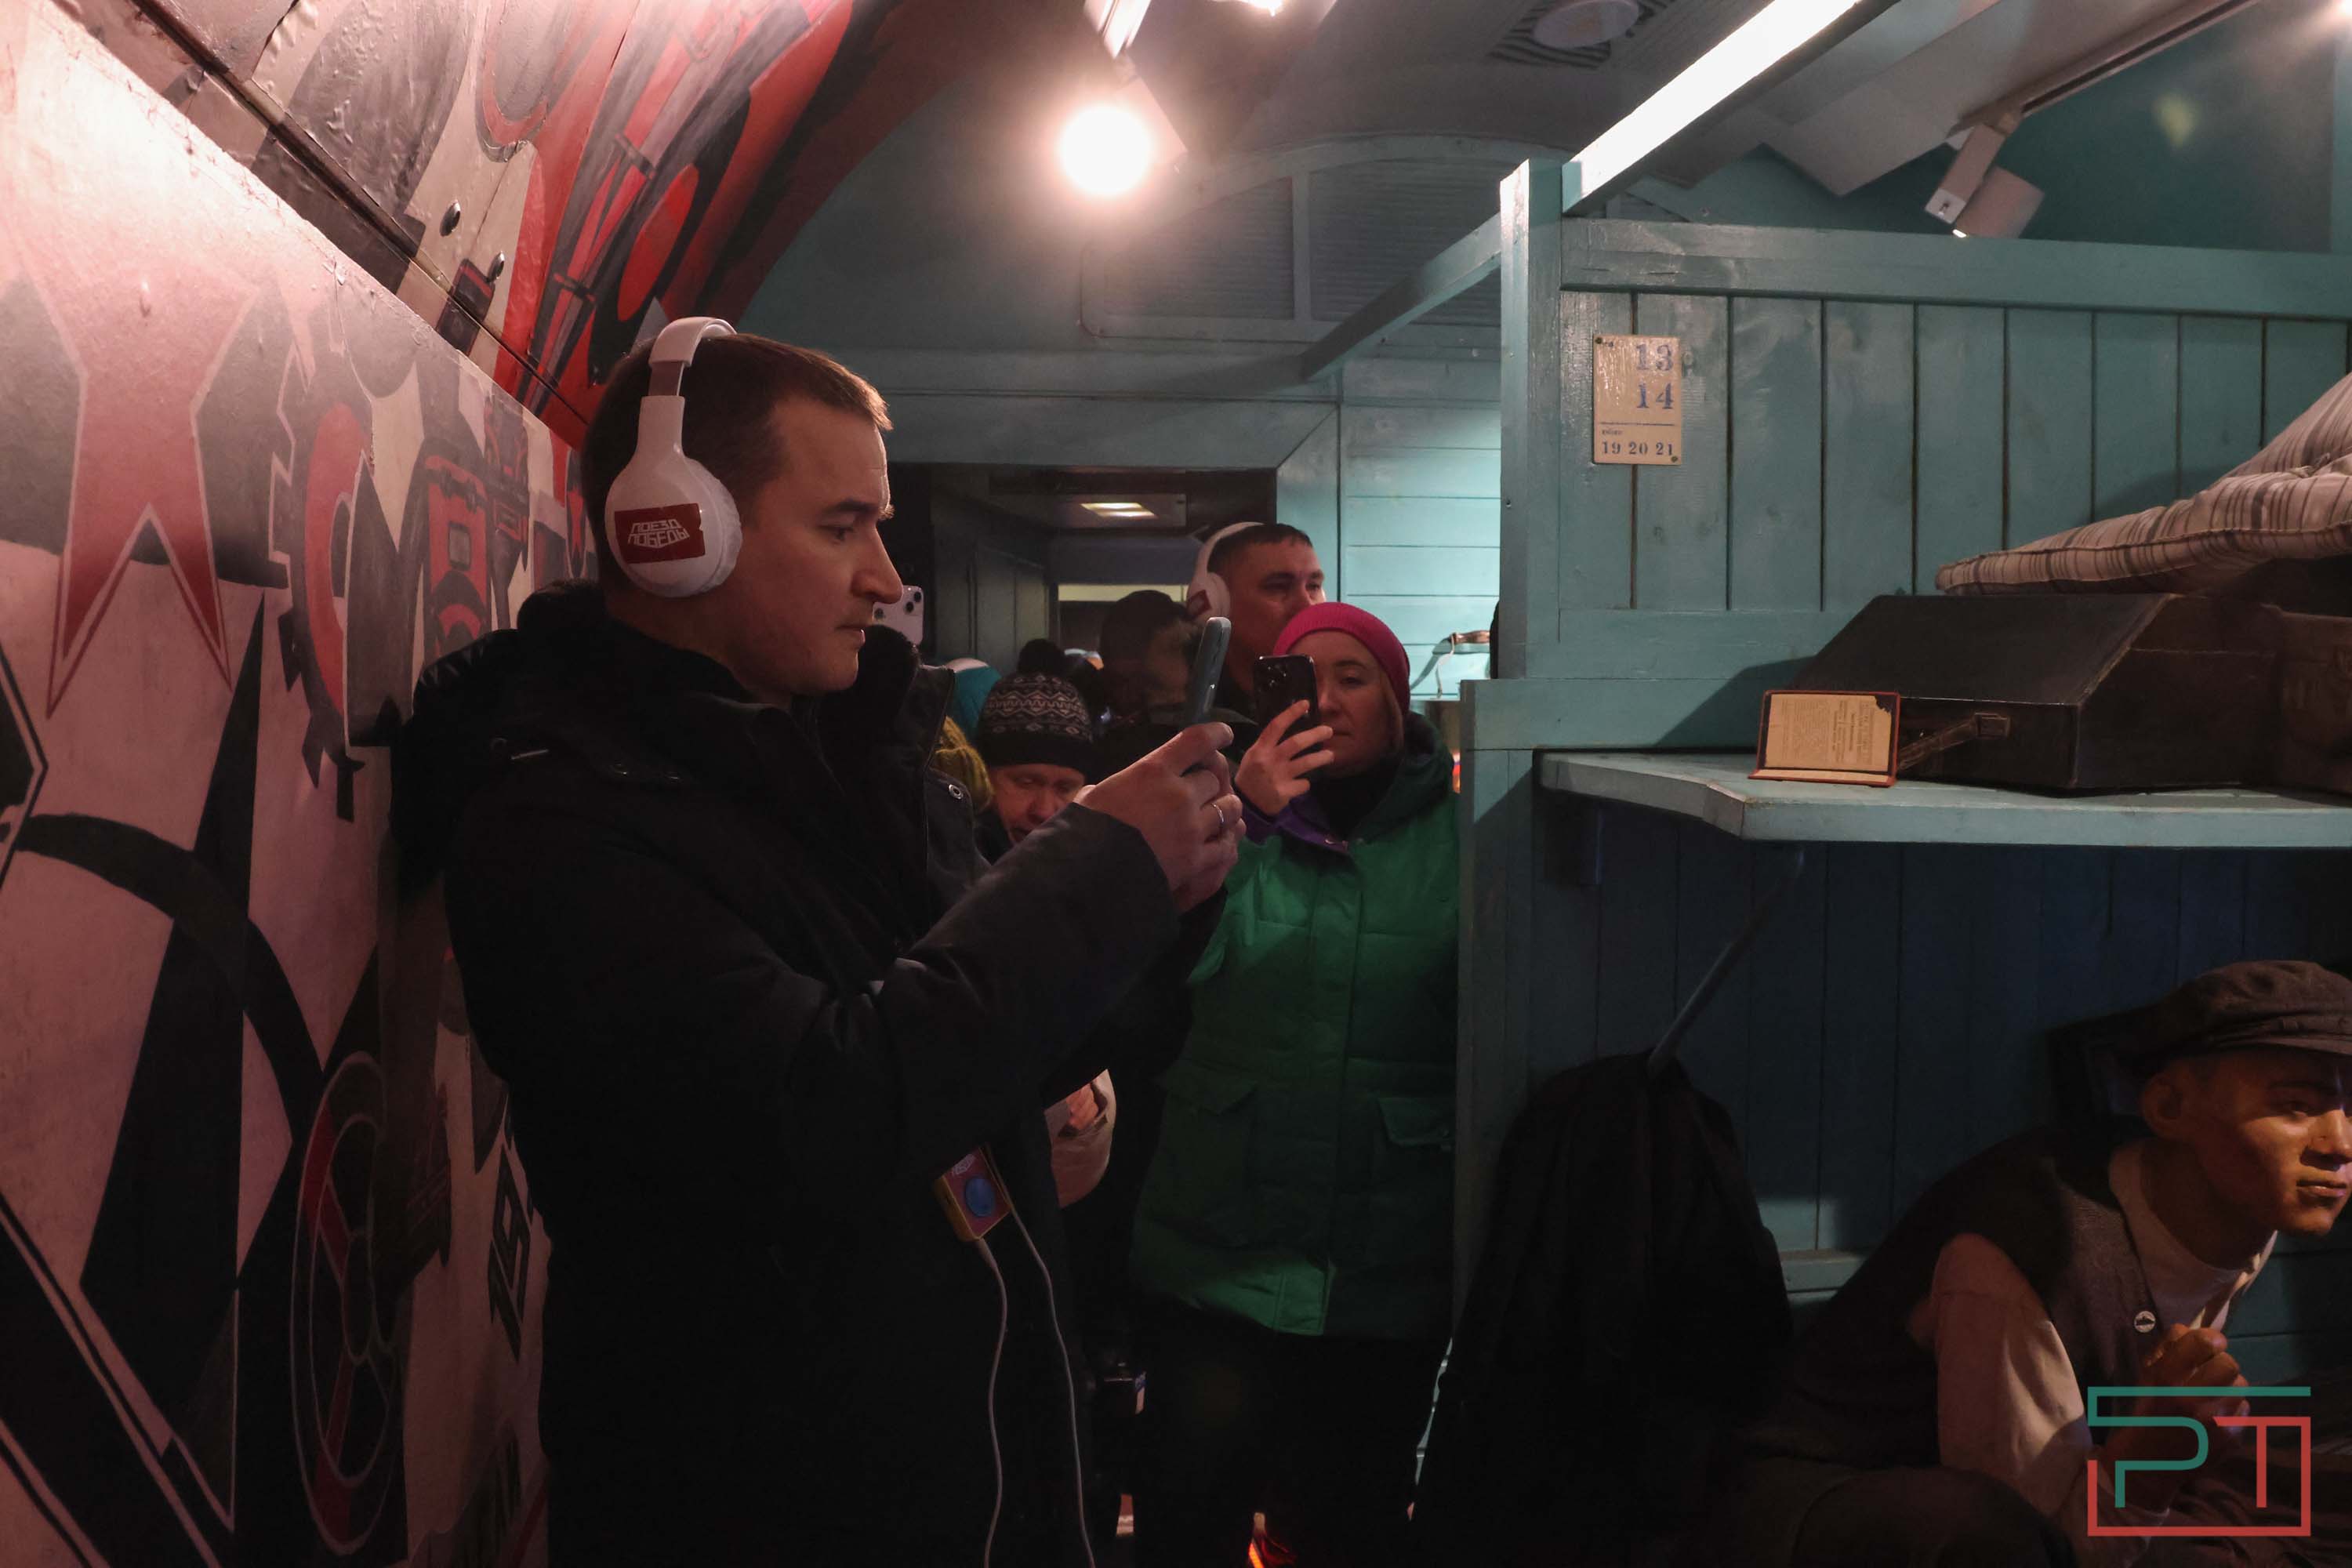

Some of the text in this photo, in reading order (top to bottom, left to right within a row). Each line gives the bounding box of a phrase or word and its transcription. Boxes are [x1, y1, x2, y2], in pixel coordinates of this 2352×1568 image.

[1635, 343, 1674, 372] 13
[1636, 382, 1674, 410] 14
[1601, 441, 1673, 456] 19 20 21
